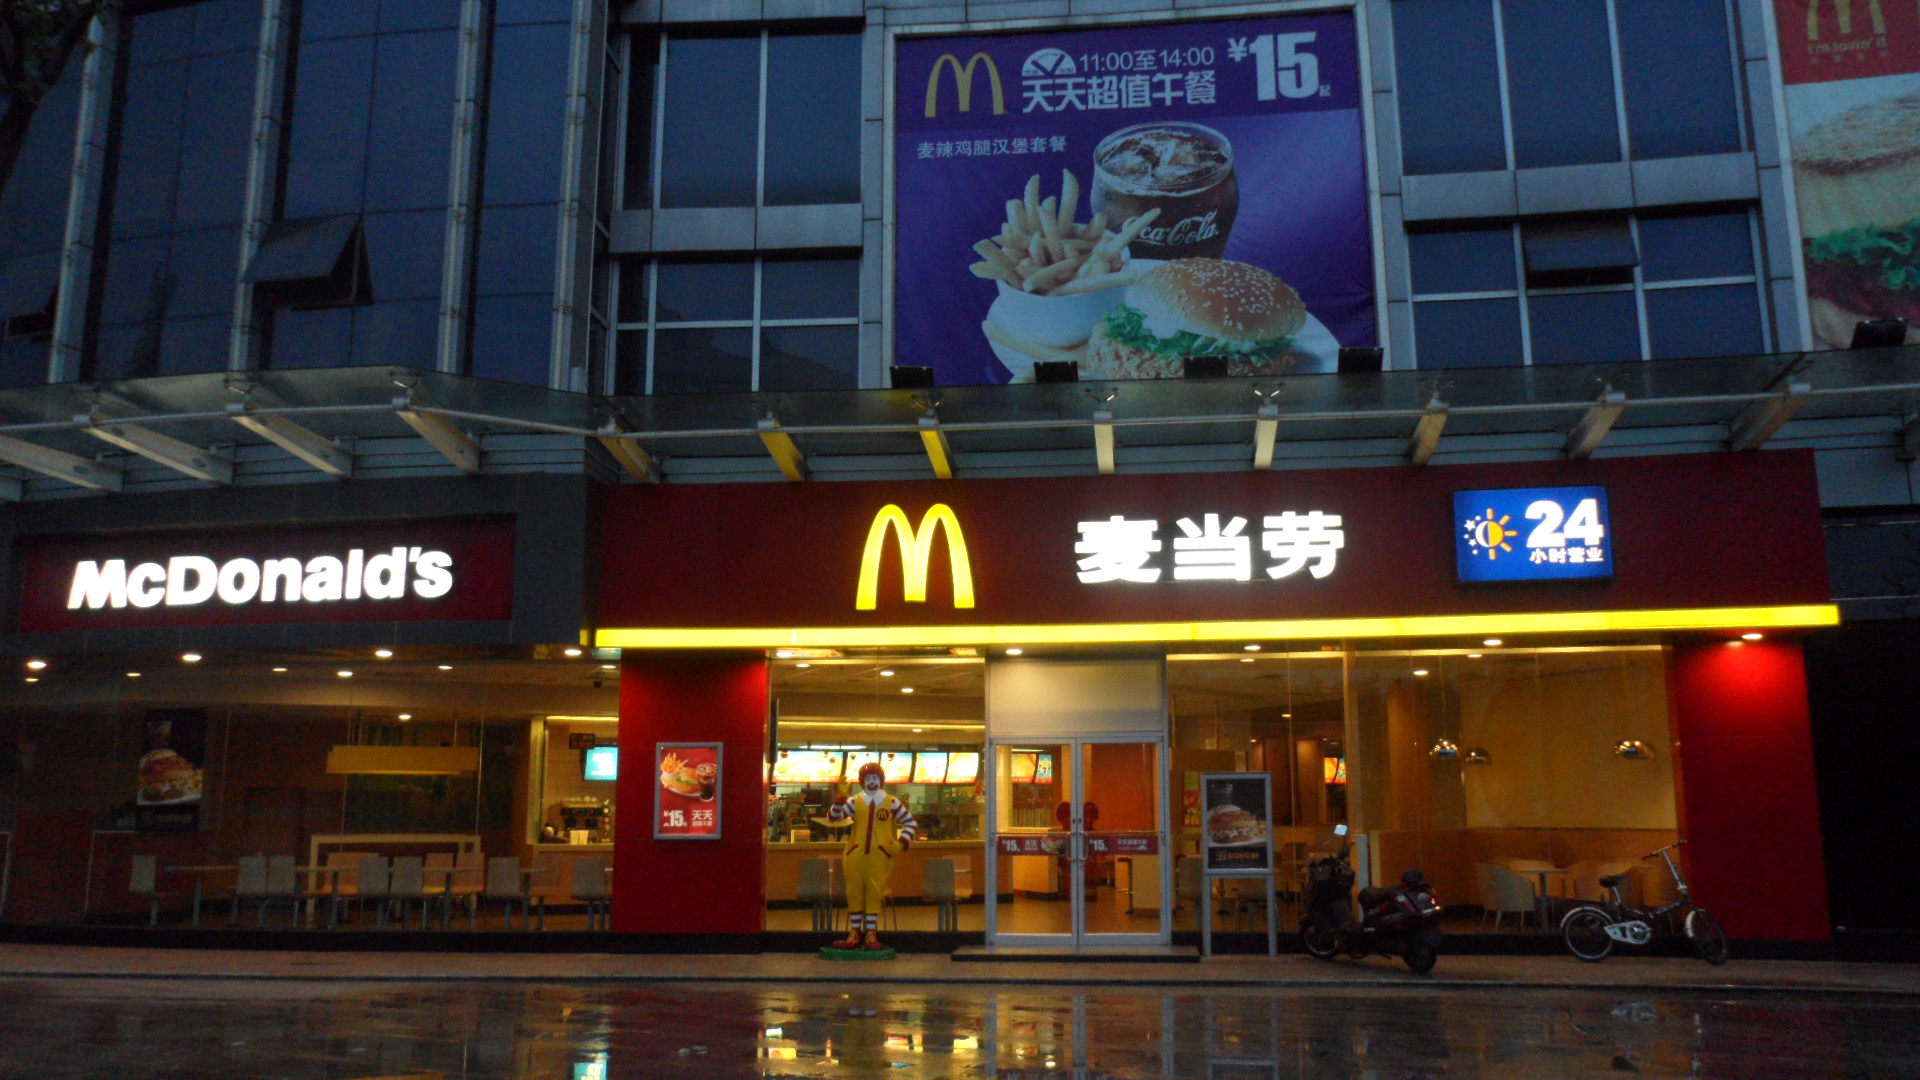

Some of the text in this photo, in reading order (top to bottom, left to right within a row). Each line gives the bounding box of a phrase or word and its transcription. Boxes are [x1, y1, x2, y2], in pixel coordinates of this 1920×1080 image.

[1022, 70, 1217, 113] 天天超值午餐
[917, 135, 1068, 160] 麦辣鸡腿汉堡套餐
[1525, 498, 1604, 548] 24
[1074, 510, 1345, 584] 麦当劳
[1529, 547, 1604, 564] 小时营业
[67, 546, 453, 609] McDonald's
